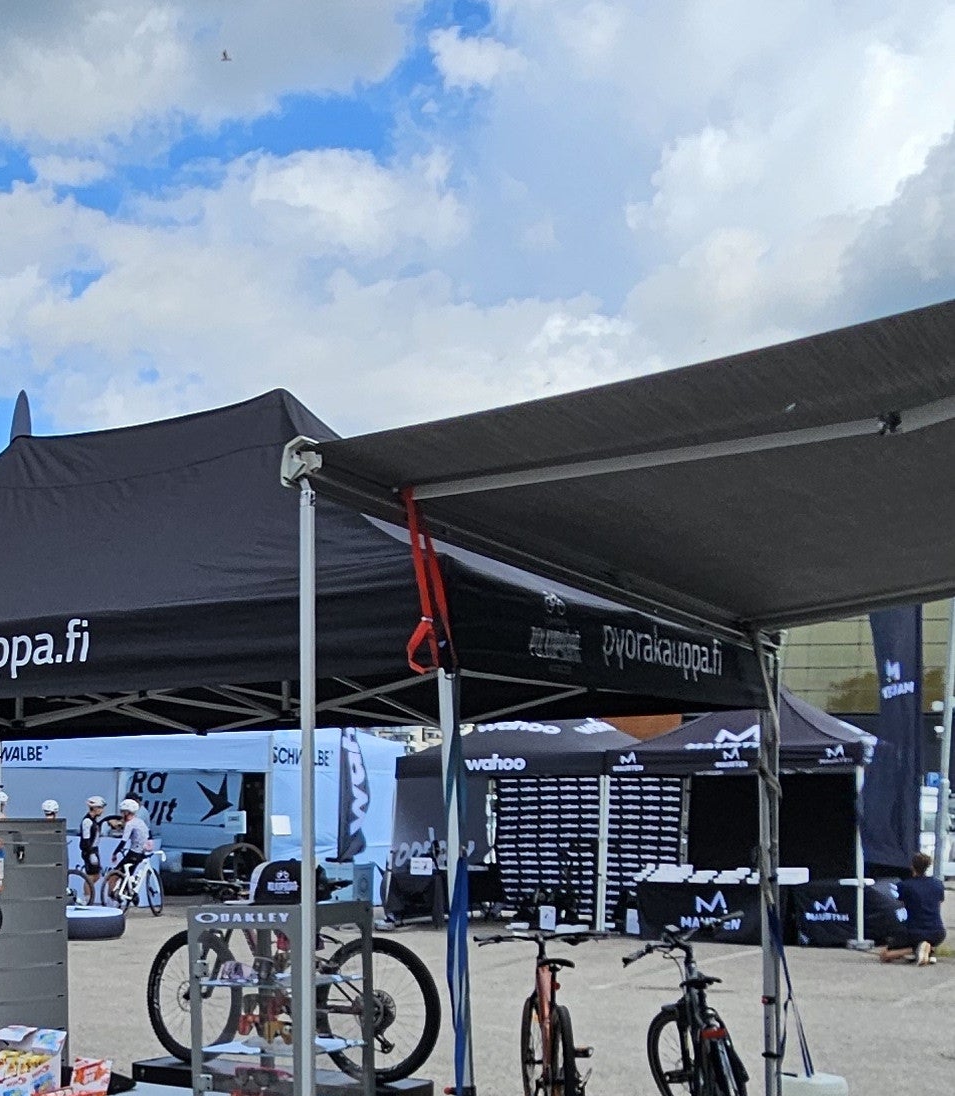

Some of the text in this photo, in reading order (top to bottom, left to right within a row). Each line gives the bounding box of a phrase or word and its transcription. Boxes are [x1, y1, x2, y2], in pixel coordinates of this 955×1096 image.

[602, 624, 722, 682] pyorakauppa.fi
[272, 747, 330, 767] SCHLBE
[464, 753, 526, 770] wahoo
[220, 912, 290, 923] OAKLEY
[680, 916, 741, 930] MAEN
